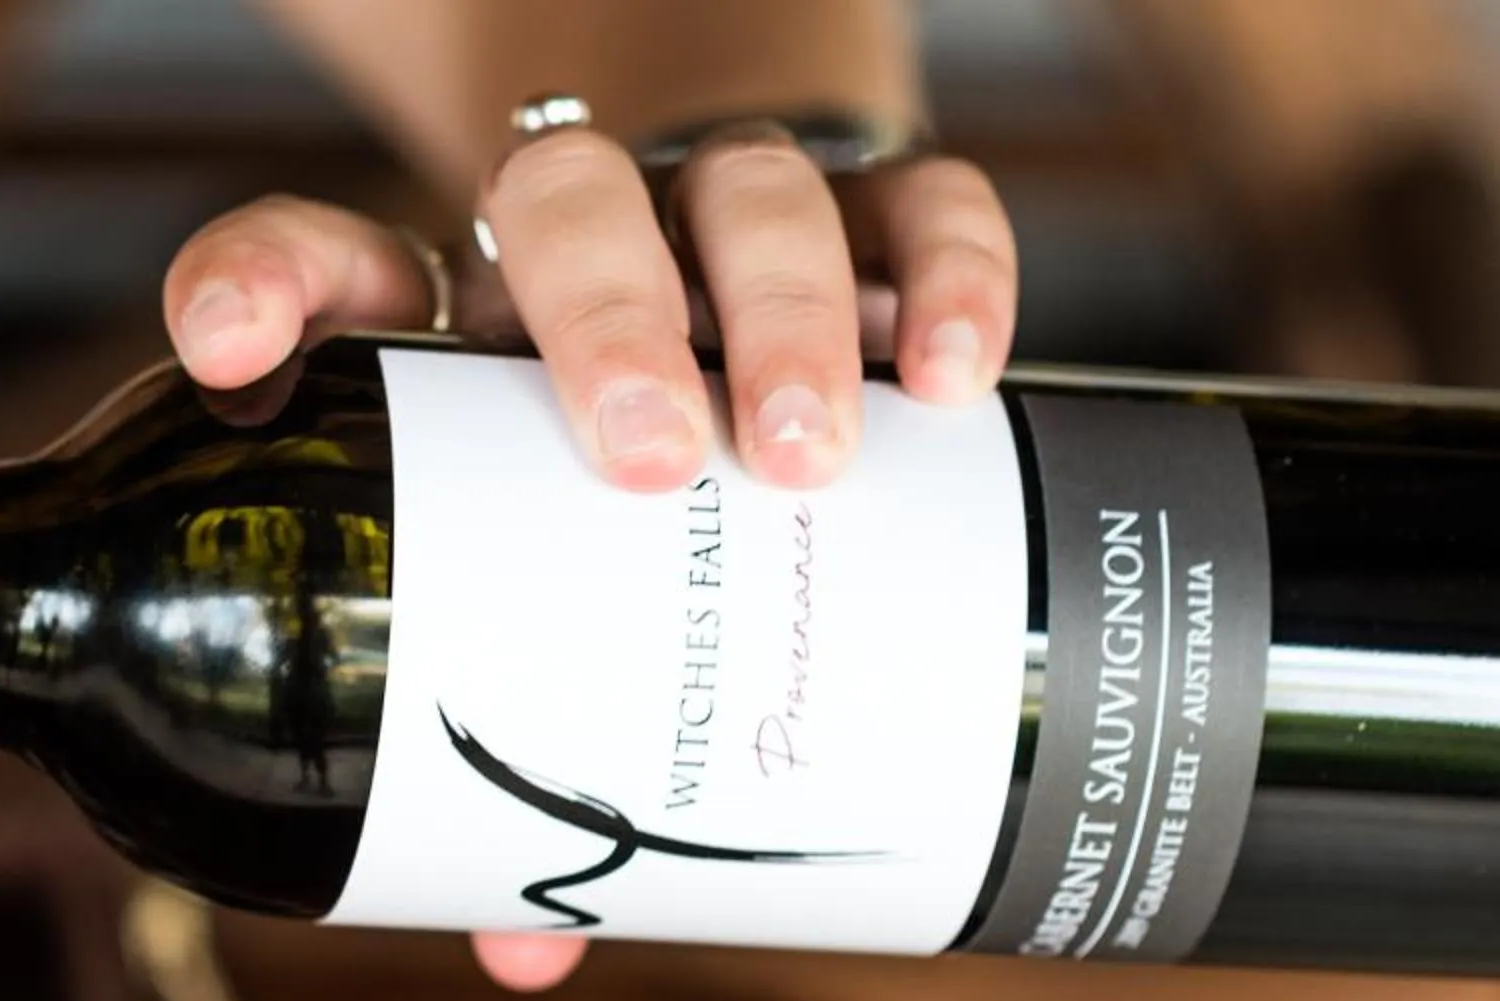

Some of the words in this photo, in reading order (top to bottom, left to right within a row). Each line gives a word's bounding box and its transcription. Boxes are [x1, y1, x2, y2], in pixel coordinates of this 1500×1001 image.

[688, 477, 721, 587] FALLS
[664, 608, 721, 810] WITCHES
[751, 503, 812, 778] Provenance
[1083, 509, 1144, 804] SAUVIGNON
[1182, 562, 1213, 725] AUSTRALIA
[1165, 748, 1201, 811] BELT
[1132, 817, 1187, 917] GRANITE
